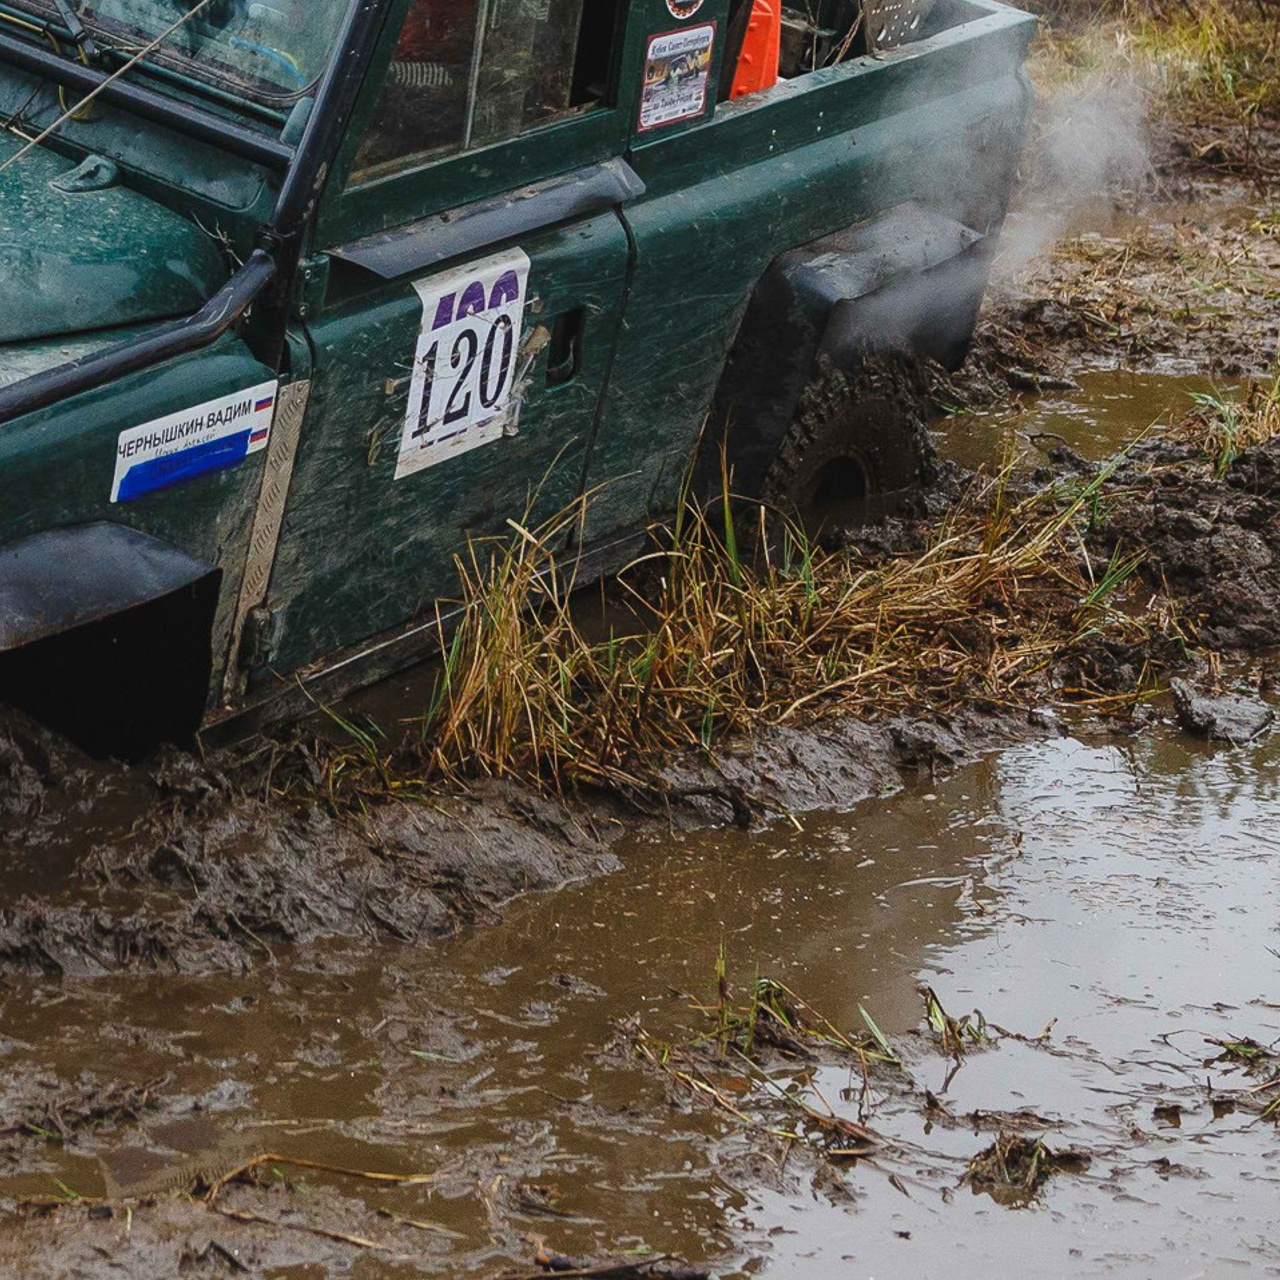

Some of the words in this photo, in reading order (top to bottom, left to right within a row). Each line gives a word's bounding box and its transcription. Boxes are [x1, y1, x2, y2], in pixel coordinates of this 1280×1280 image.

[412, 313, 514, 439] 120
[118, 417, 204, 459] ЧЕРНЫШКИН
[206, 399, 253, 428] ВАДИМ
